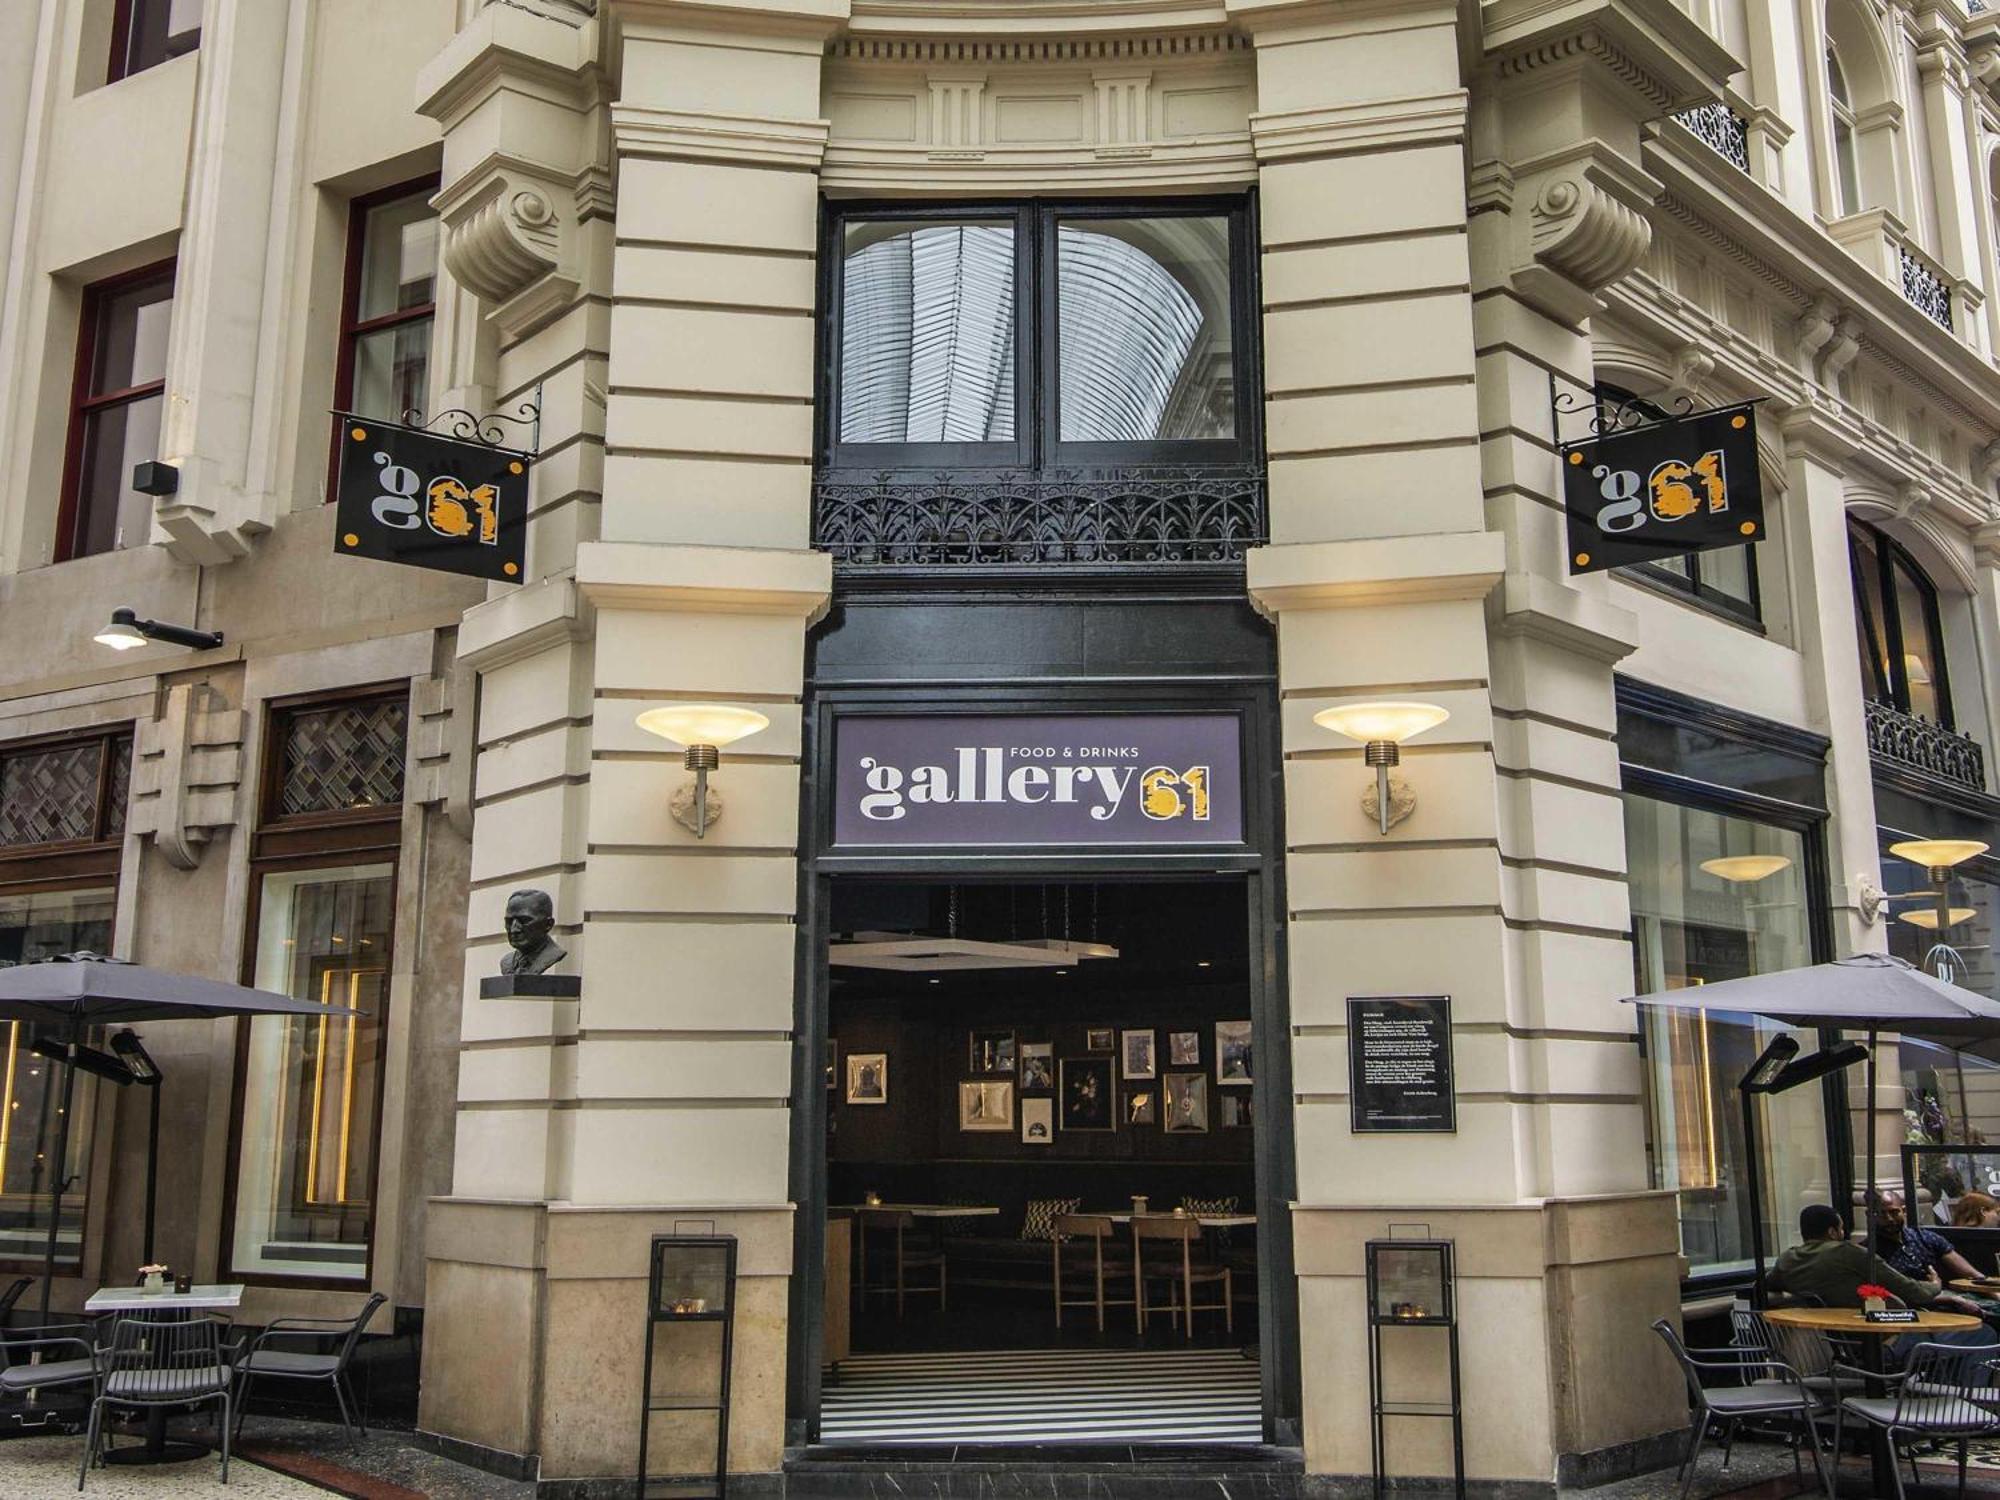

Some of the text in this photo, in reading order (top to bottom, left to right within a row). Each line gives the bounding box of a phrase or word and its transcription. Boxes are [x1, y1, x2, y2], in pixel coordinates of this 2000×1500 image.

[1010, 747, 1140, 758] FOOD & DRINKS
